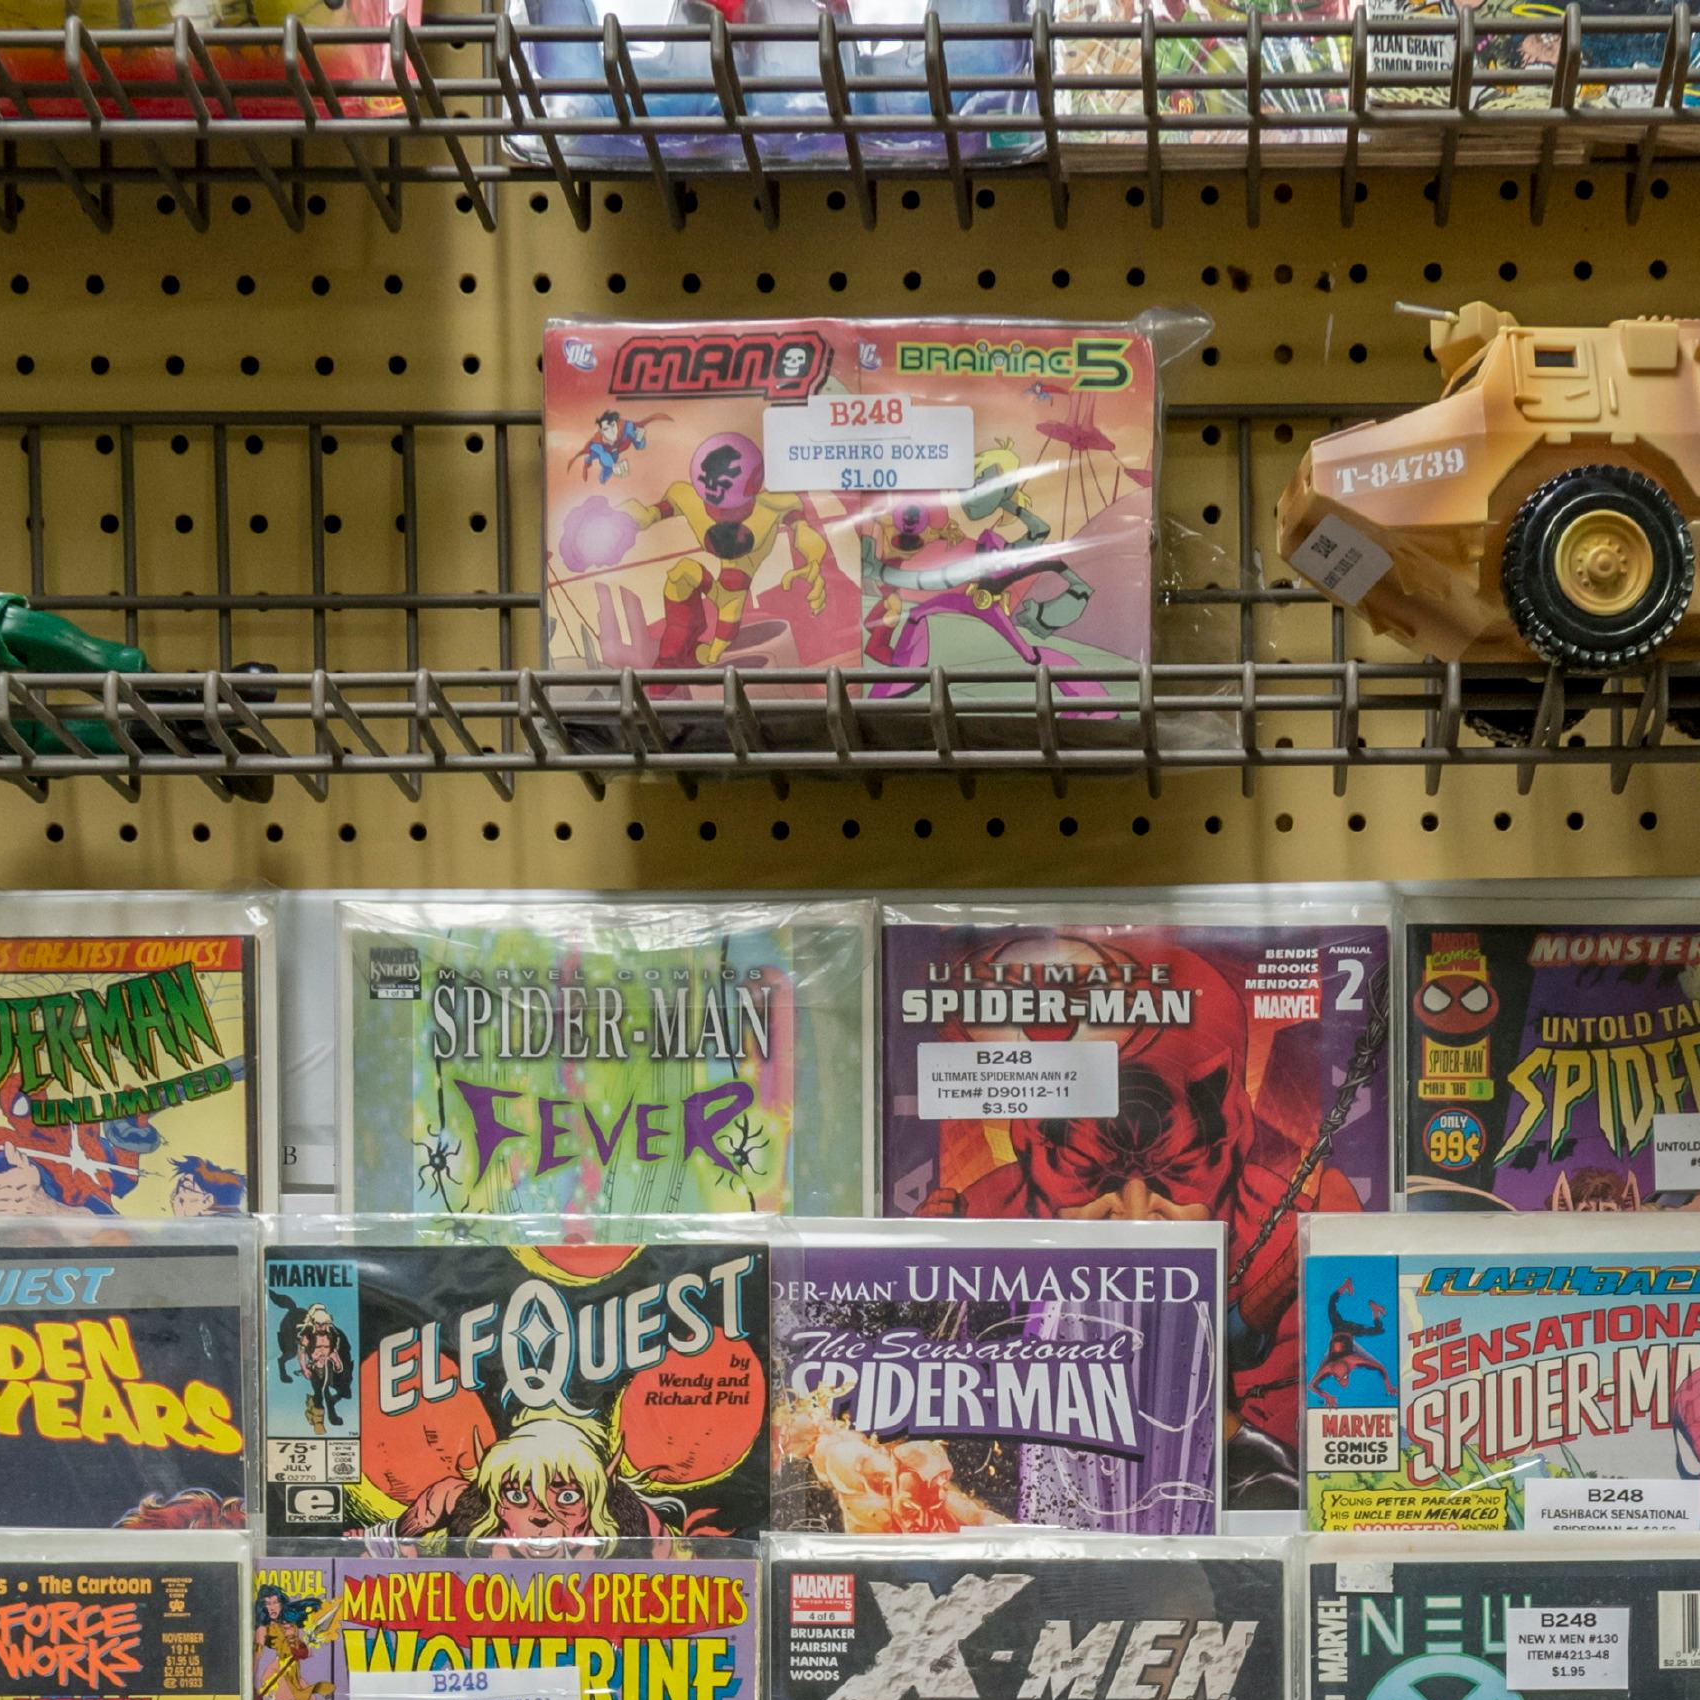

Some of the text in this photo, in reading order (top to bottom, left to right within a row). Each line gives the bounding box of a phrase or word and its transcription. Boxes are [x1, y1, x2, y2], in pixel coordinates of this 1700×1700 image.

[831, 402, 902, 426] B248
[789, 444, 949, 461] SUPERHRO BOXES
[1337, 448, 1465, 492] T-84739
[841, 469, 898, 489] $1.00
[1265, 948, 1318, 960] BENDIS
[929, 964, 1170, 984] ULTIMATE
[1258, 963, 1318, 975] BROOKS
[1245, 978, 1318, 990] MENDOZA
[902, 990, 1191, 1026] SPIDER-MAN
[433, 983, 770, 1060] SPIDER-MAN
[977, 1051, 1032, 1064] B248
[982, 1101, 1028, 1114] $3.50
[456, 1079, 755, 1186] FEVER
[909, 1267, 1199, 1301] UNMASKED
[380, 1255, 756, 1416] ELFQUEST
[658, 1372, 749, 1390] Wendy and
[644, 1390, 749, 1407] Richard Pini
[343, 1573, 747, 1626] MARVEL COMICS PRESENTS
[1541, 1613, 1597, 1629] B248
[791, 1628, 855, 1639] BRUBAKER
[791, 1642, 848, 1652] HAIRSINE
[791, 1656, 837, 1666] HANNA
[791, 1670, 840, 1681] WOODS
[1552, 1665, 1585, 1677] $1.95
[432, 1672, 488, 1692] B248
